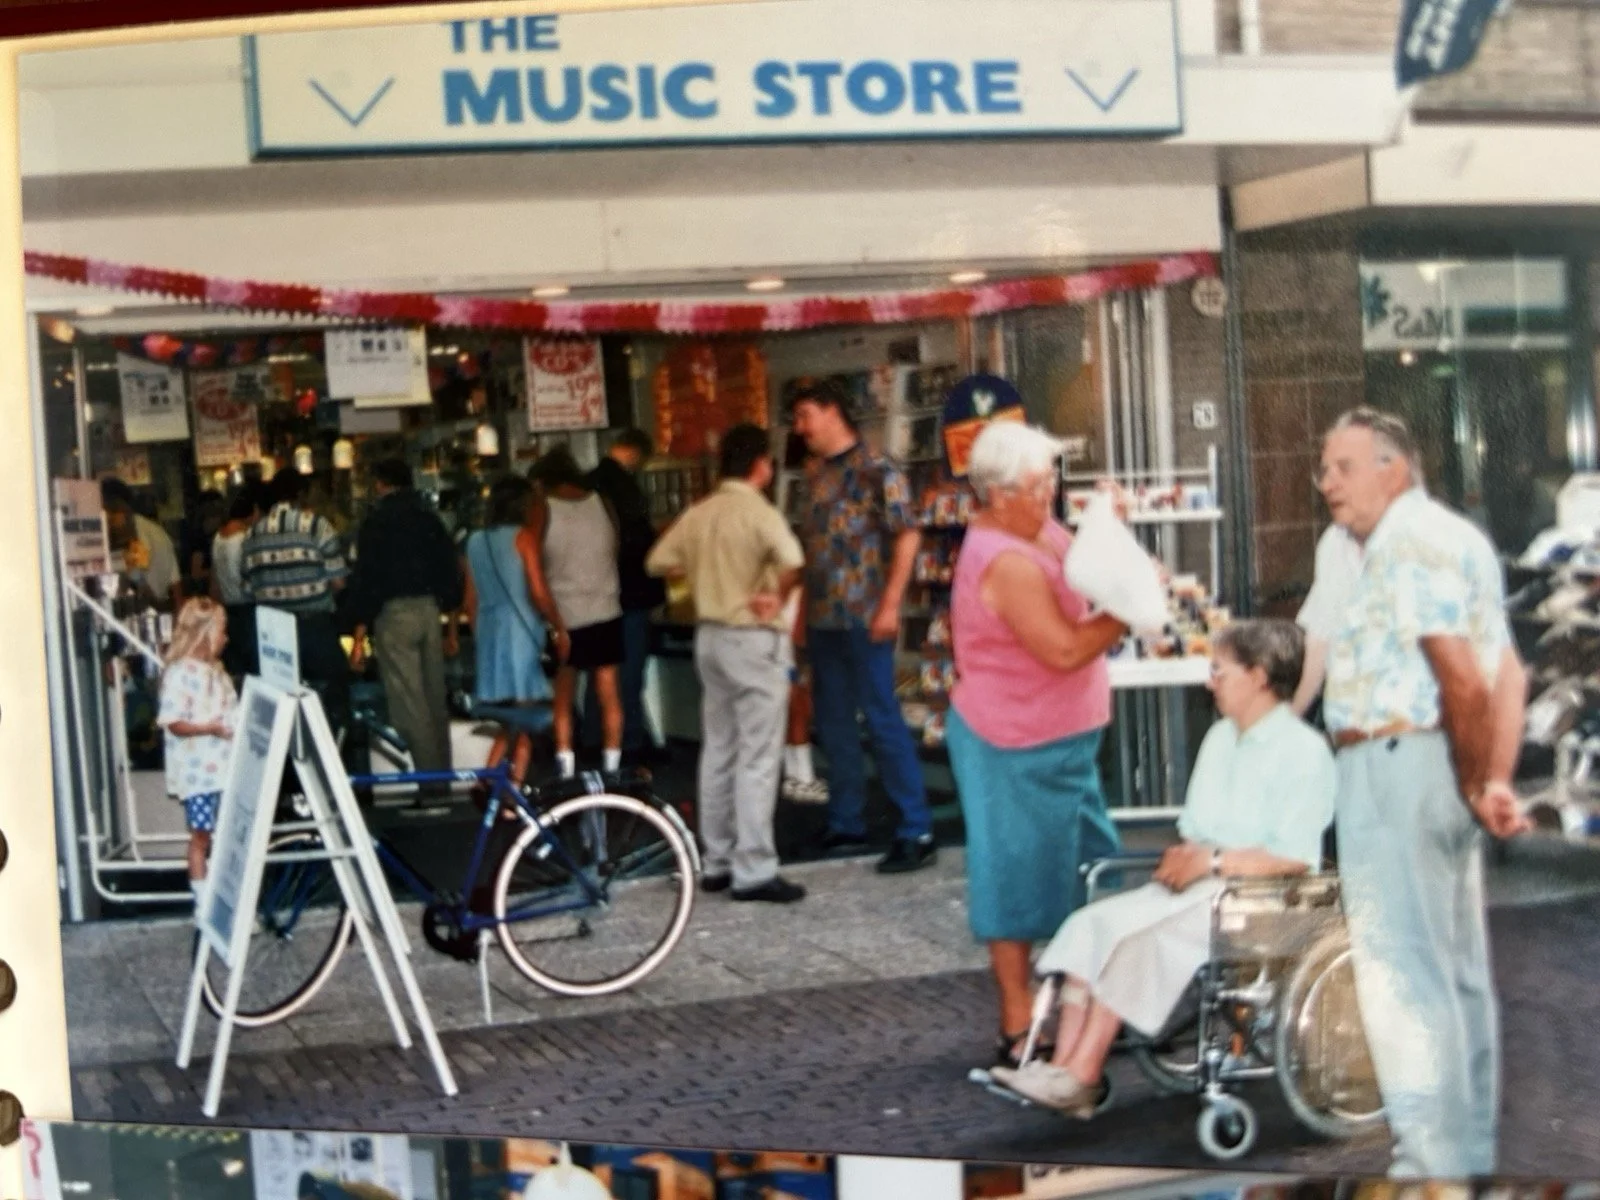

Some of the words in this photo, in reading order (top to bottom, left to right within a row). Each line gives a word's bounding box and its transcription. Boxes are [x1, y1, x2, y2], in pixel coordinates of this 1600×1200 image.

[445, 14, 560, 53] THE
[442, 61, 719, 126] MUSIC
[753, 59, 1022, 118] STORE
